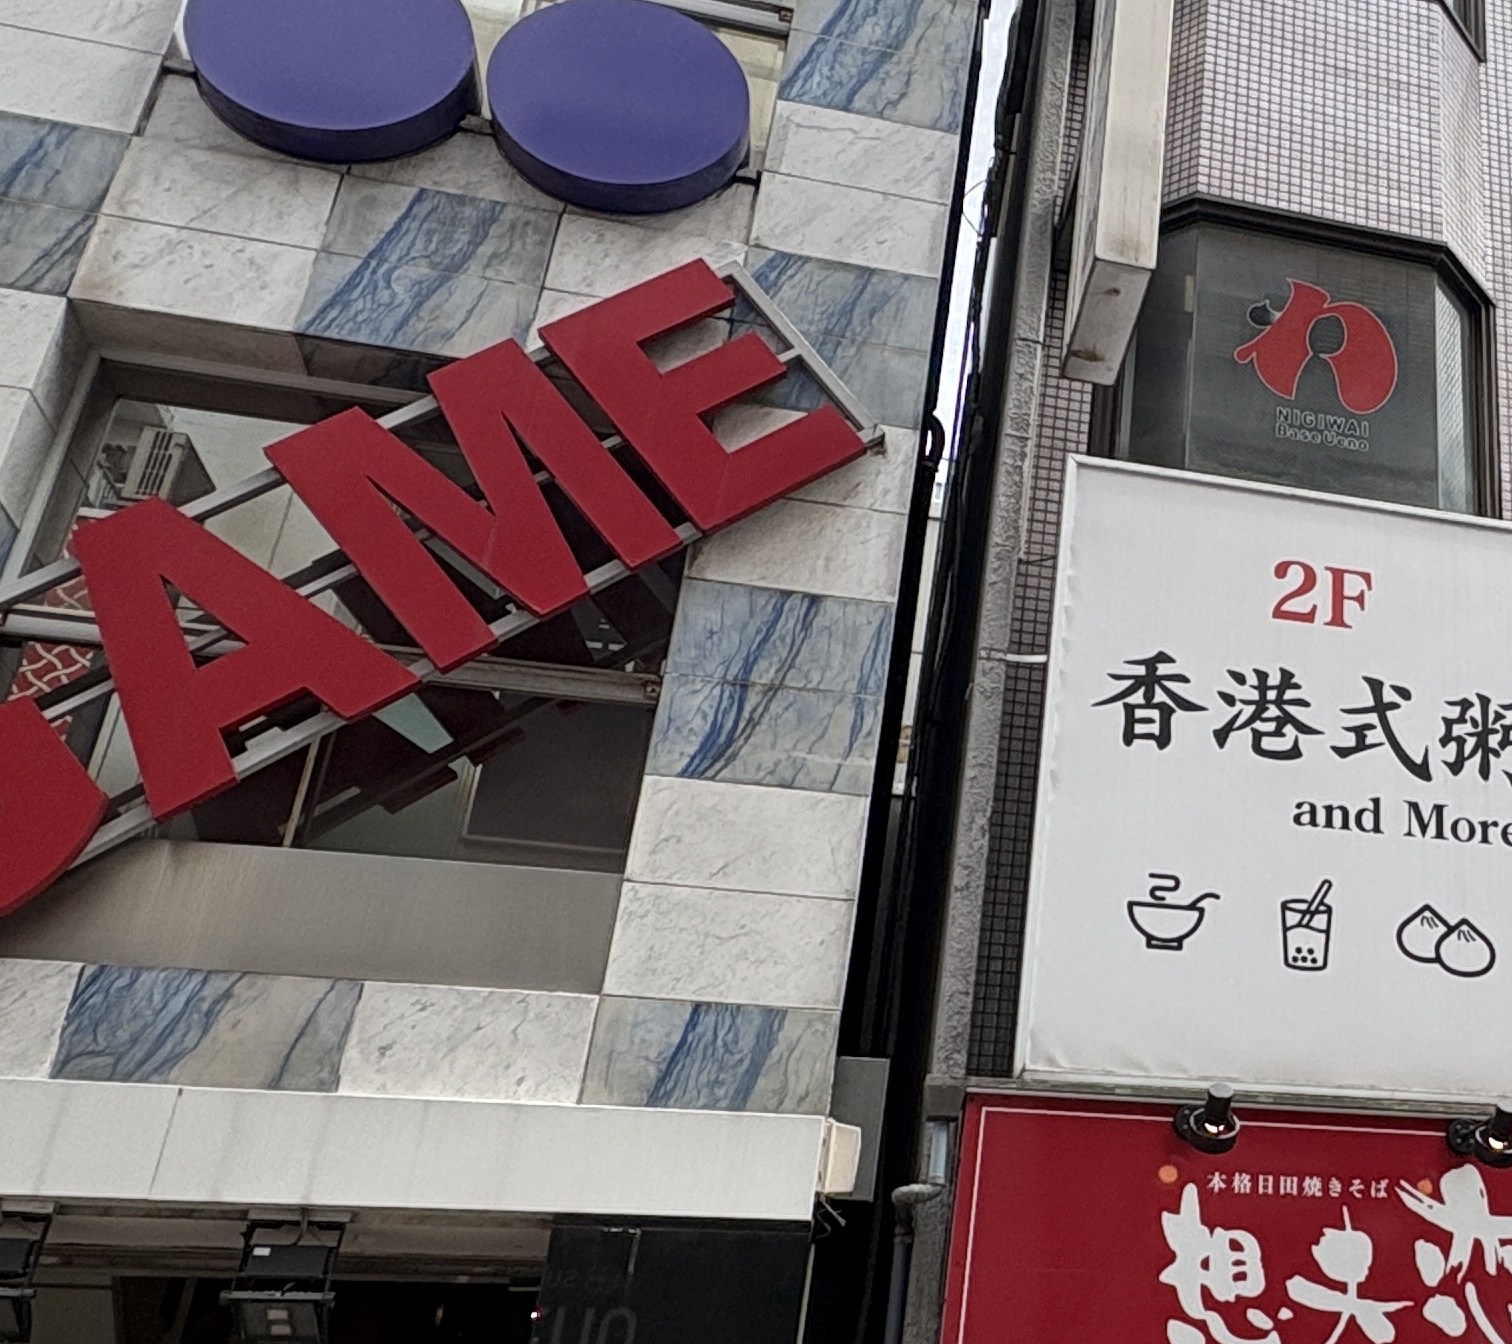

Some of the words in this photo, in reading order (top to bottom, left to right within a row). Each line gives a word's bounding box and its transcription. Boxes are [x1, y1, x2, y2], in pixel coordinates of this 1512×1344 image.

[1275, 422, 1322, 444] Base
[1323, 432, 1370, 452] Ueno
[1276, 406, 1370, 438] NIGIWAI
[0, 258, 866, 916] AME
[1271, 559, 1373, 629] 2F
[1291, 797, 1384, 836] and
[1206, 1170, 1390, 1199] 本格日田焼きそば
